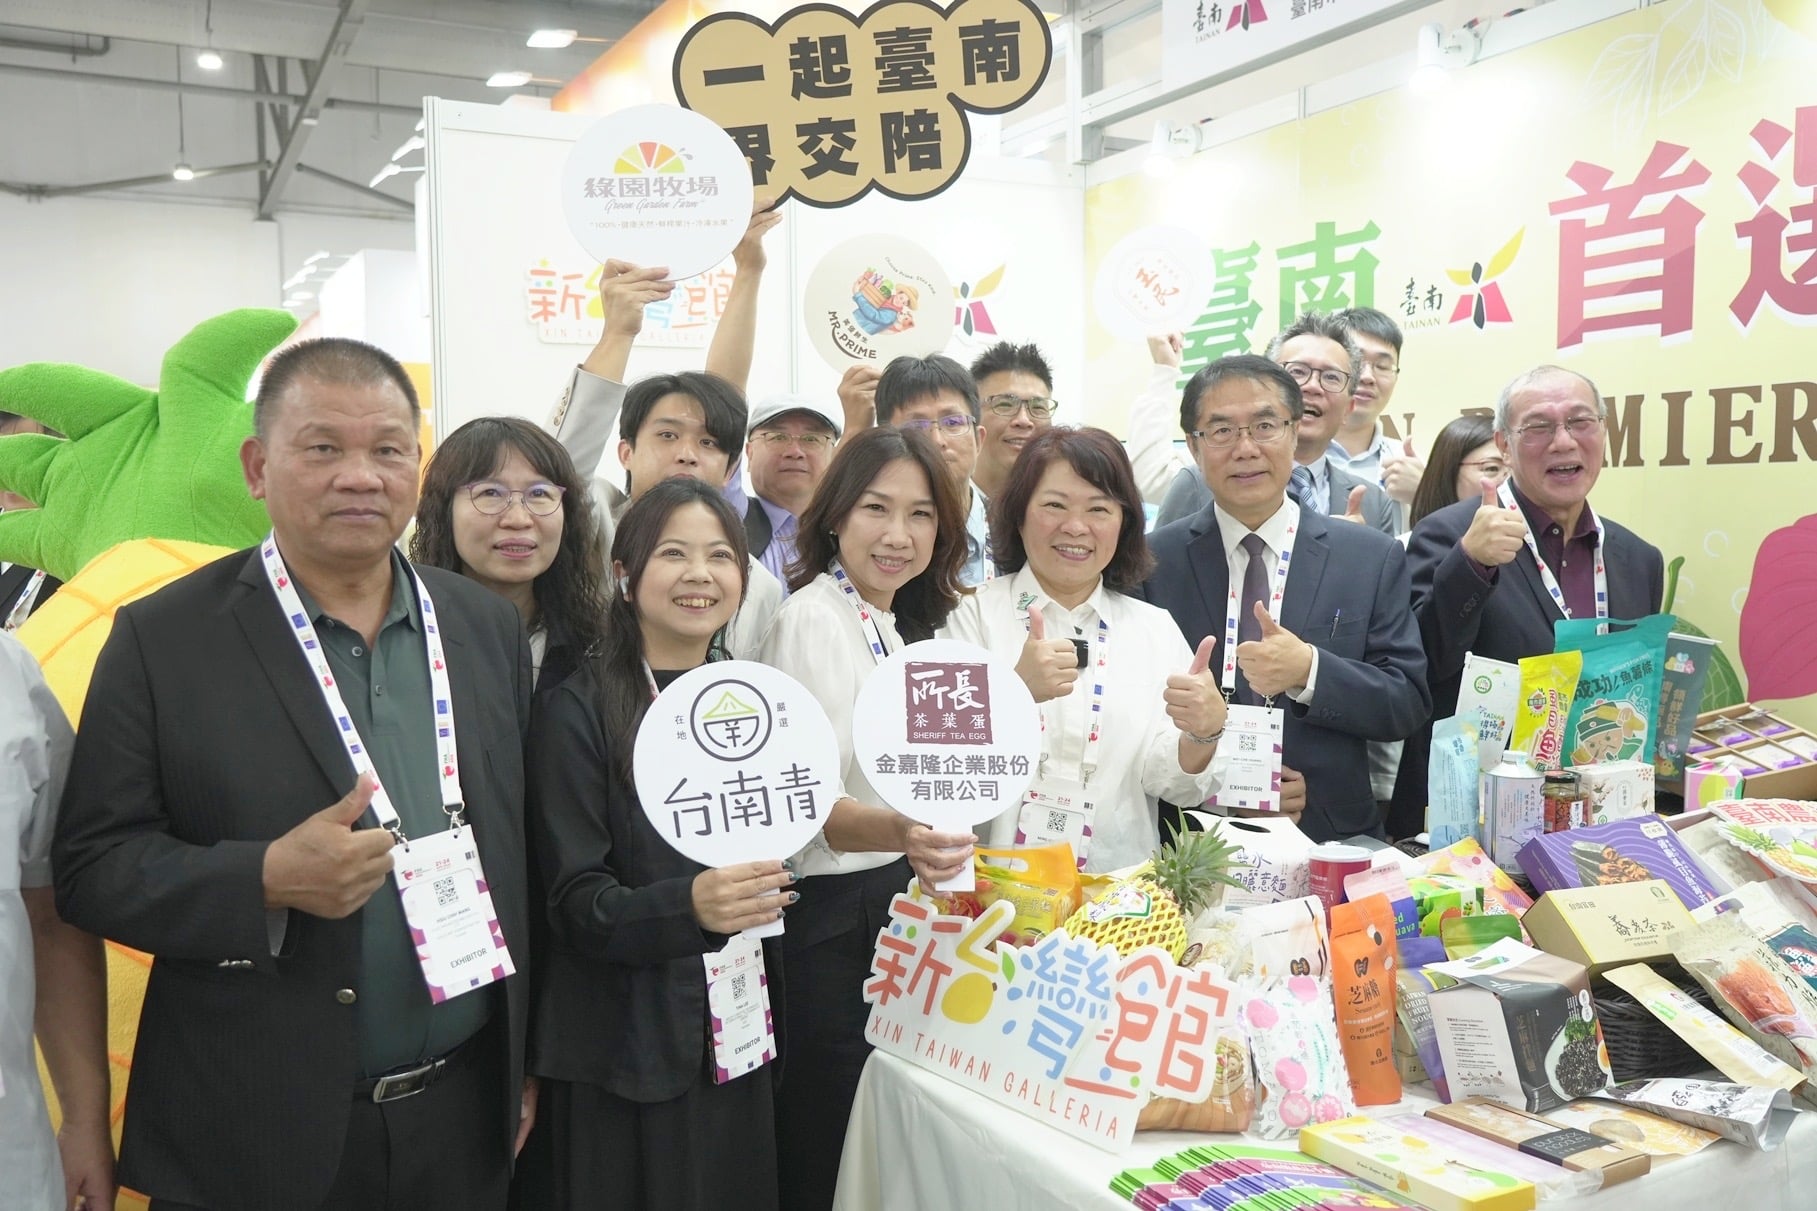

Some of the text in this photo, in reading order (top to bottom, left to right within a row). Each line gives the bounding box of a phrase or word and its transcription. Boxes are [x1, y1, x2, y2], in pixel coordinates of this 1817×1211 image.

[703, 18, 1021, 101] 一起臺南
[733, 108, 942, 187] 界交陪
[583, 176, 719, 198] 綠園牧場
[604, 199, 633, 214] Green
[636, 199, 669, 214] Garden
[1400, 277, 1443, 316] 臺南
[1403, 318, 1441, 330] TAINAN
[1460, 382, 1817, 468] MIER
[911, 669, 985, 710] 所長
[776, 702, 789, 728] 嚴選
[914, 713, 985, 730] 茶葉蛋
[674, 714, 687, 740] 在地
[913, 731, 986, 740] SHERIFF TEA EGG
[876, 753, 1029, 776] 金嘉隆企業股份
[911, 780, 999, 801] 有限公司
[1229, 784, 1263, 793] EXHIBITOR
[664, 763, 821, 839] 台南青
[1394, 912, 1405, 925] ed
[1396, 923, 1416, 940] uava
[450, 948, 488, 968] EXHIBITOR
[867, 885, 1229, 1099] 新台灣館
[734, 1036, 761, 1055] EXHIBITOR
[871, 1015, 1119, 1140] XIN TAIWAN GALLERIA
